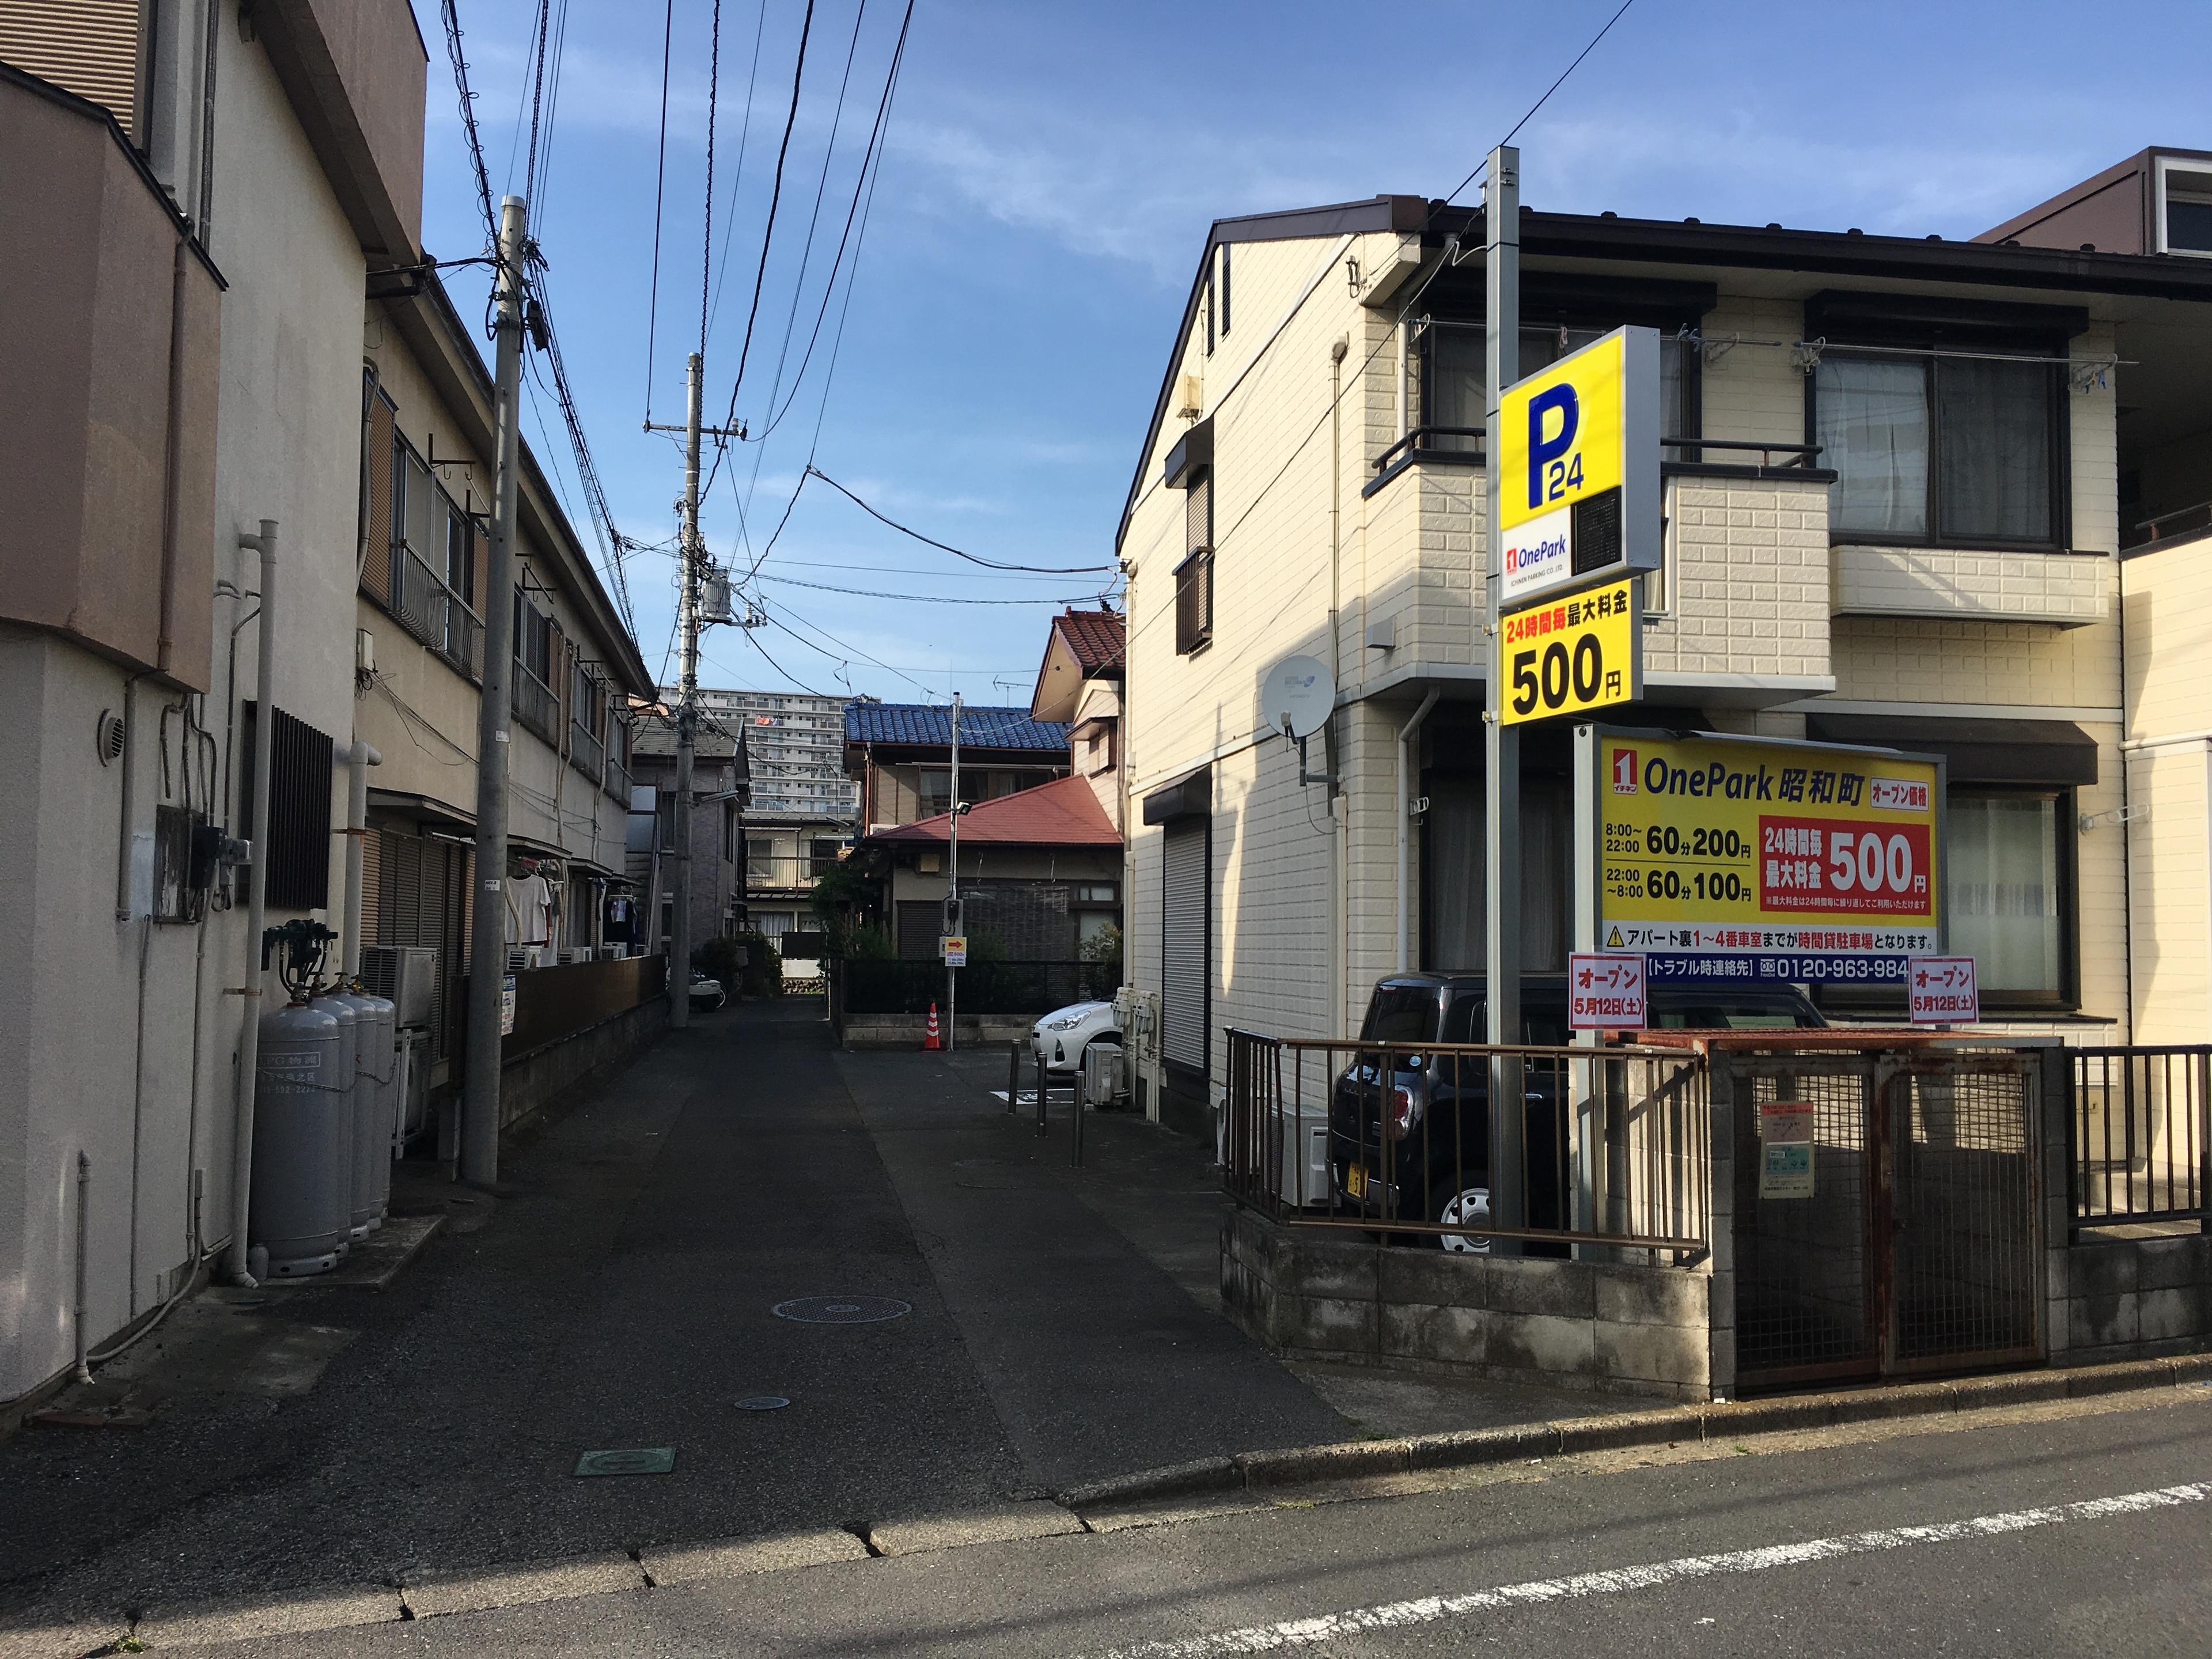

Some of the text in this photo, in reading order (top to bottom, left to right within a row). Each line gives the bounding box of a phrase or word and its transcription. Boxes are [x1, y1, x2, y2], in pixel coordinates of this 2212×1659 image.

[1529, 383, 1579, 510] P
[1549, 452, 1584, 502] 24
[1519, 534, 1566, 568] OnePark
[1511, 577, 1527, 586] ICHINEN
[1528, 570, 1546, 581] PARKING
[1506, 589, 1628, 644] 24時間毎最大料金
[1513, 633, 1621, 715] 500円
[1645, 757, 1774, 801] OnePark
[1778, 768, 1865, 806] 昭和町
[1873, 784, 1926, 806] オープン価格
[1606, 839, 1639, 853] 22:00
[1765, 827, 1822, 857] 24時間毎
[1606, 869, 1640, 881] 22:00
[1766, 859, 1822, 889] 最大料金
[1830, 832, 1926, 893] 500円
[1578, 964, 1638, 990] オープン
[1649, 958, 1753, 977] 【トラブル時連絡先】
[1777, 959, 1908, 978] 0120-963-984
[1916, 965, 1969, 988] オープン
[1574, 997, 1642, 1016] 5月12日(土)
[1914, 994, 1974, 1012] 5月12日(土)
